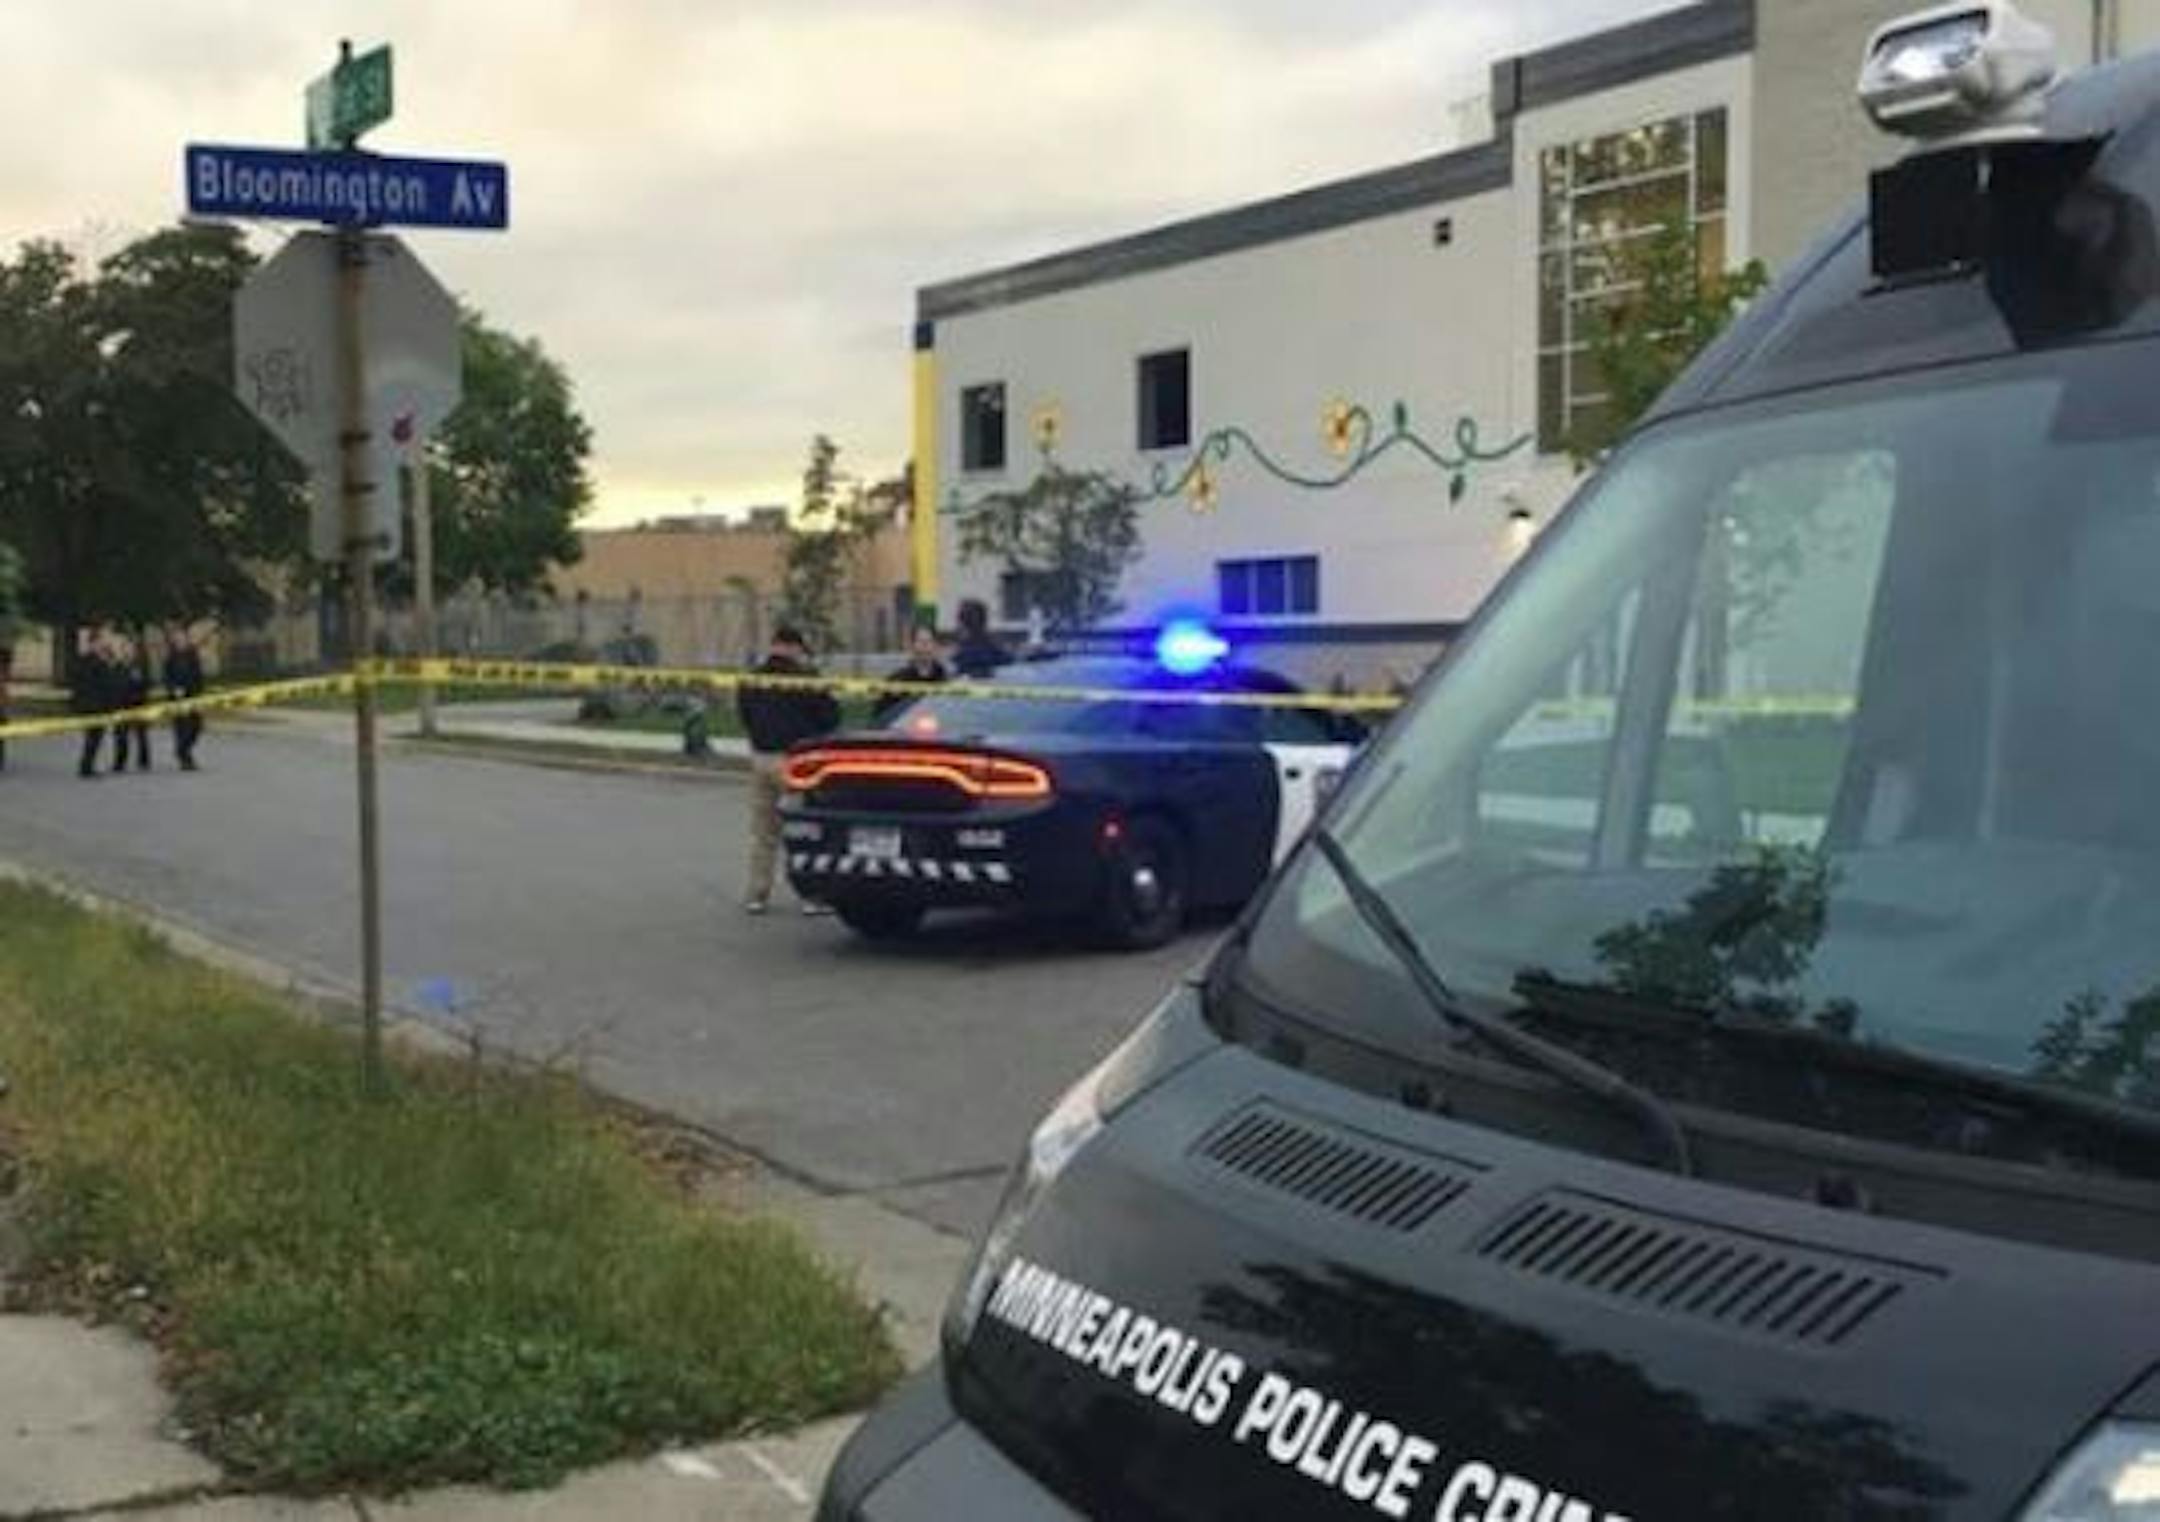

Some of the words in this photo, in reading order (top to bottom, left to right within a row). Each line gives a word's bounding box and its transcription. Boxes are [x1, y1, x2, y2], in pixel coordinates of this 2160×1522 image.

[196, 154, 425, 219] Bloomington
[451, 170, 497, 214] Av
[987, 1257, 1243, 1425] MINNEAPOLIS
[1234, 1373, 1437, 1519] POLICE
